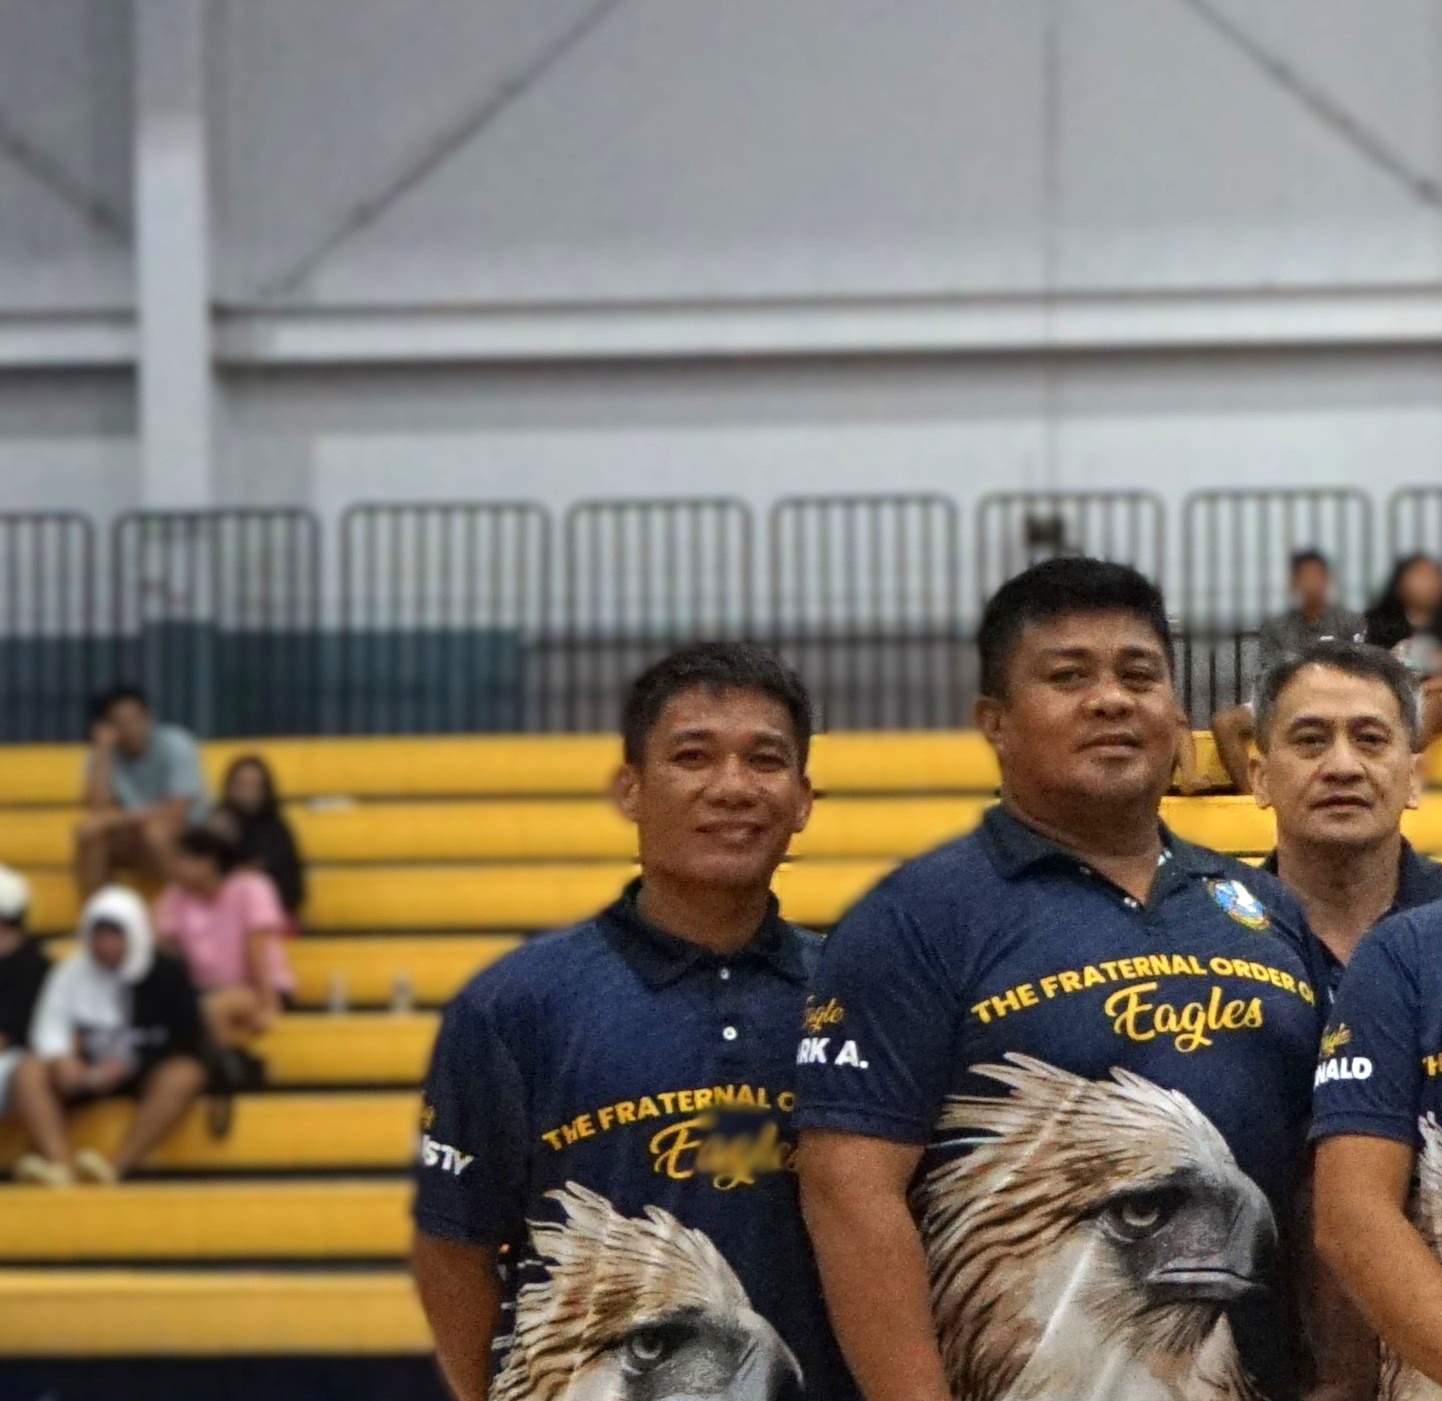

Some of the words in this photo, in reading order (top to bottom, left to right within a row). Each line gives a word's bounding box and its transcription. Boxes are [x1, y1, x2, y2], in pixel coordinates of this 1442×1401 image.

[971, 983, 1040, 1024] THE
[1040, 954, 1207, 999] FRATERNAL
[1209, 956, 1297, 994] ORDER
[1104, 981, 1263, 1052] Eagles
[834, 1040, 869, 1069] A.
[541, 1112, 597, 1151] THE
[597, 1083, 772, 1131] FRATERNAL
[422, 1132, 475, 1176] STY
